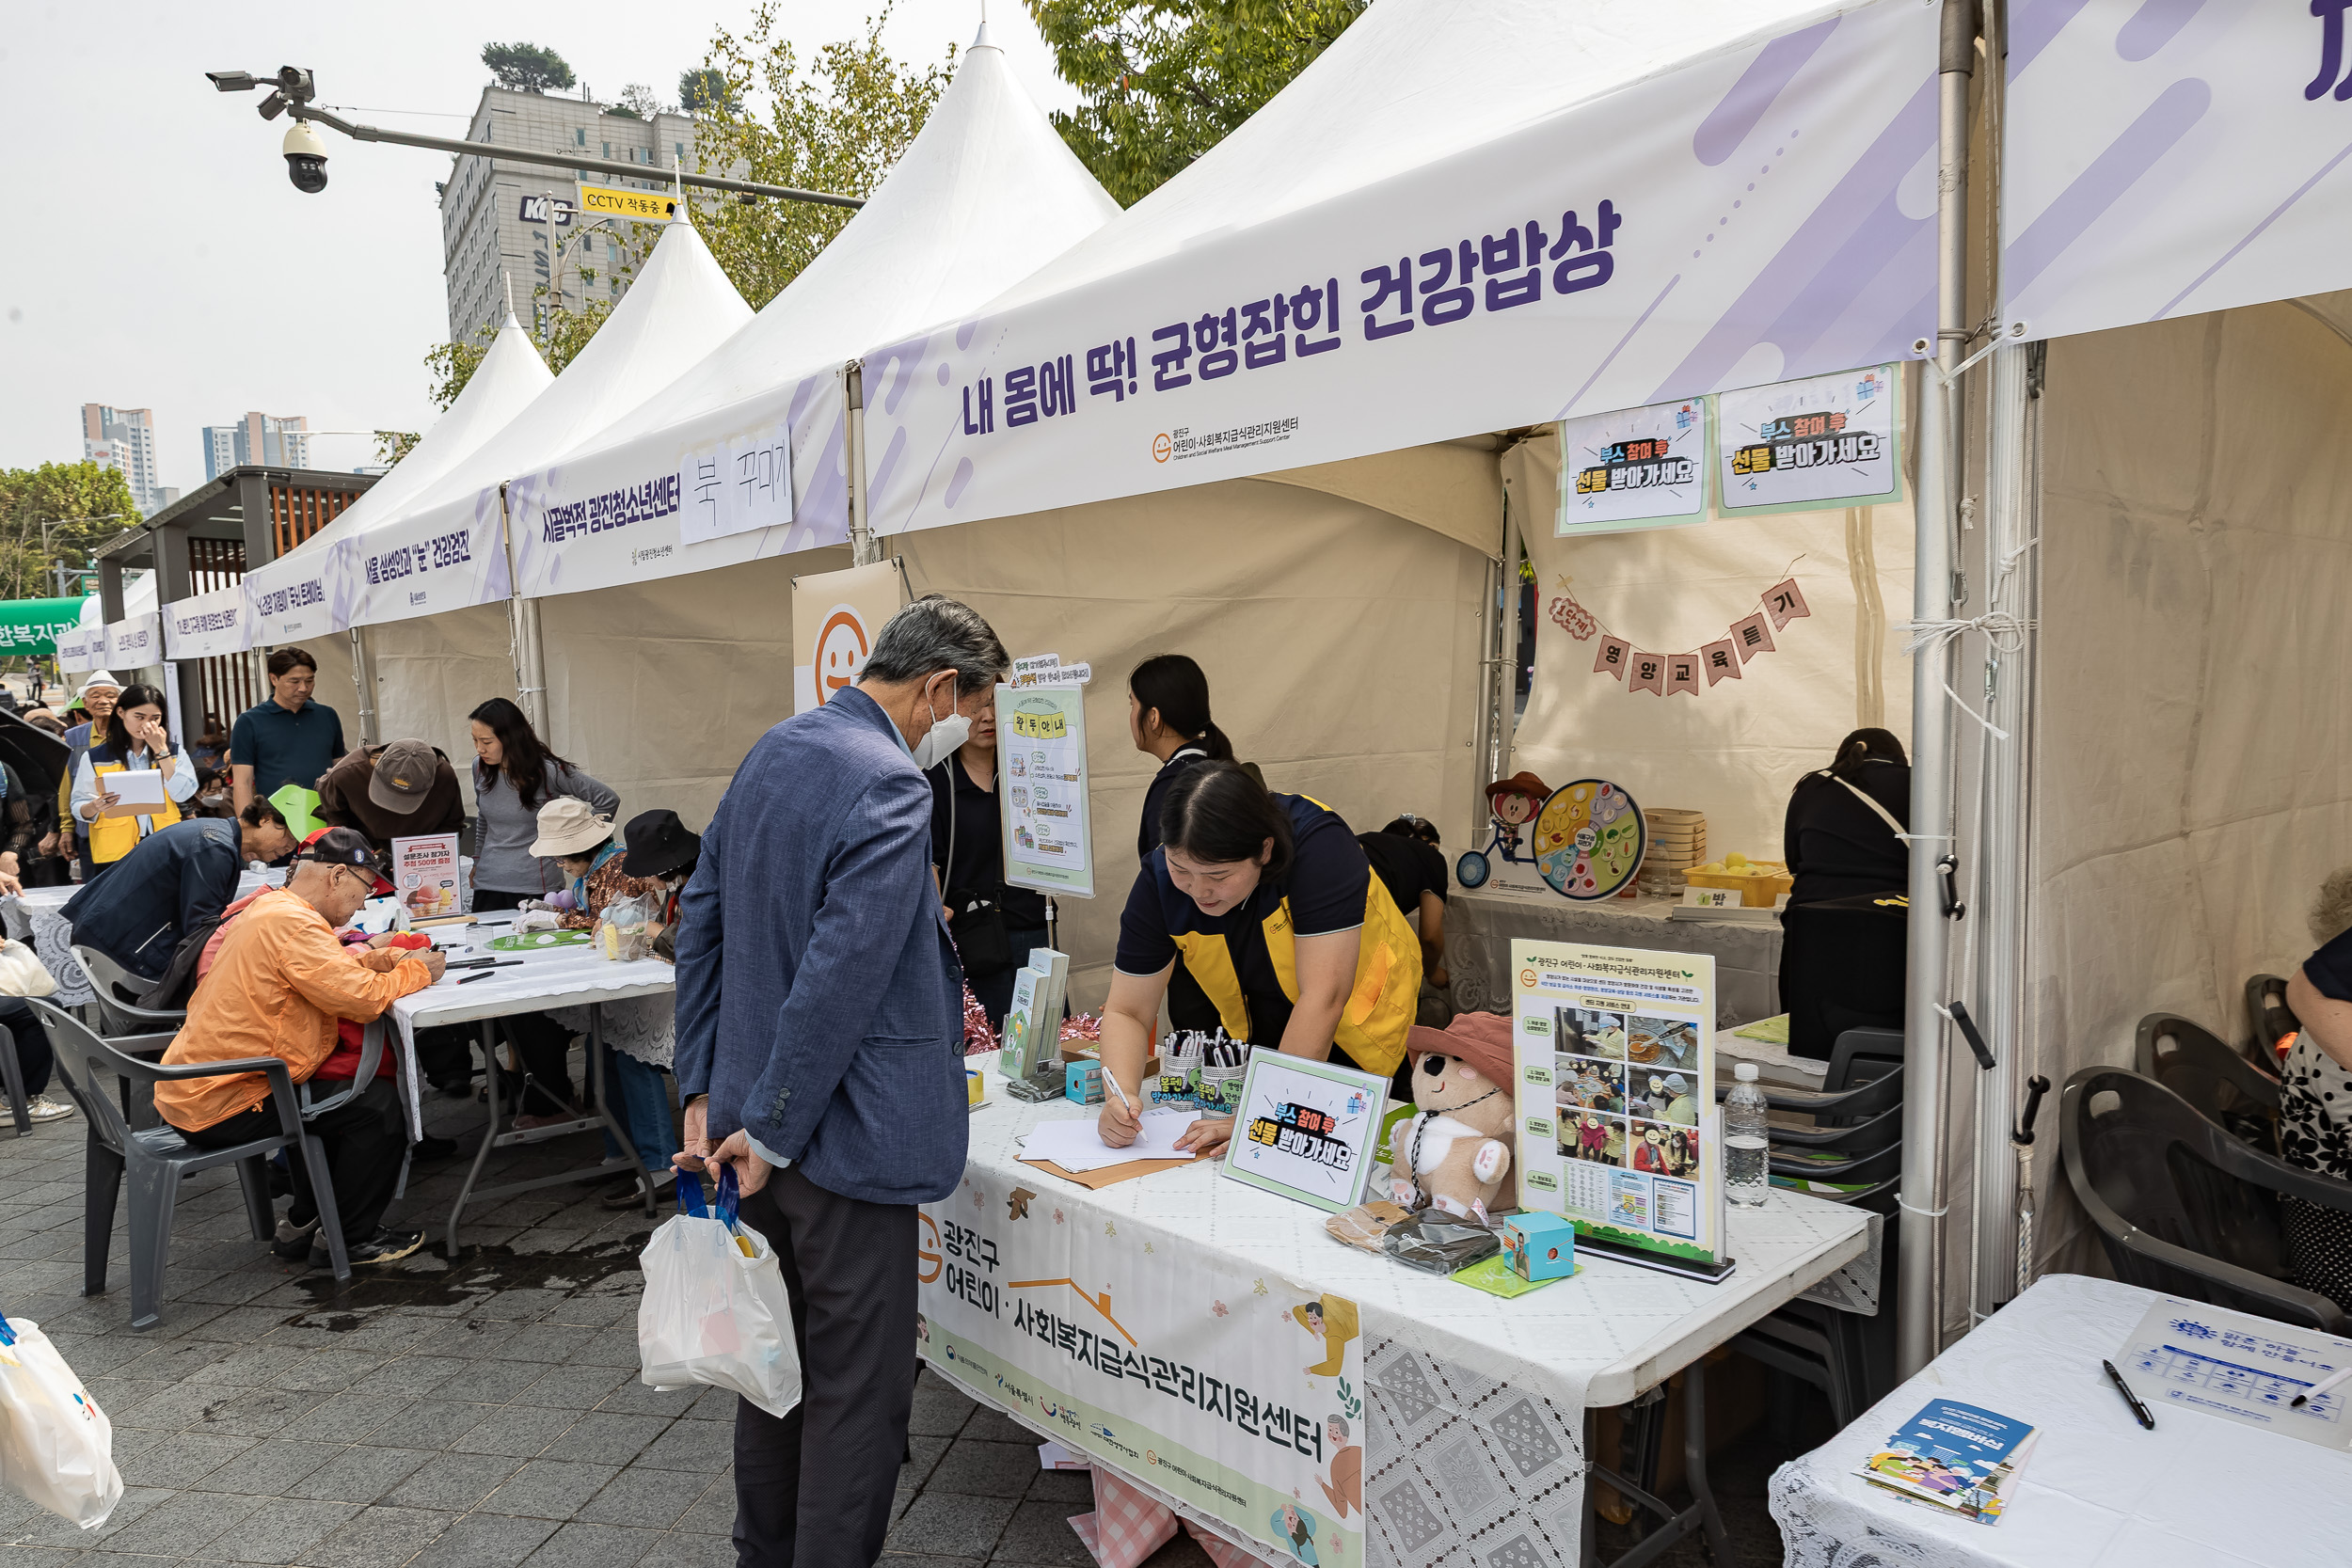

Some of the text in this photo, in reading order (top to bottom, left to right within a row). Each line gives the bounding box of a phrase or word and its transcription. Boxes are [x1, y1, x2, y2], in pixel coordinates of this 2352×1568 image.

[587, 193, 660, 214] CCTV 작동중
[962, 198, 1622, 436] 내 몸에 딱! 균형잡힌 건강밥상
[1172, 427, 1190, 439] 광진구
[1760, 411, 1848, 441] 부스 참여 후
[1599, 438, 1669, 465] 부스 참여 후
[1731, 435, 1882, 475] 선물 받아가세요
[693, 438, 787, 527] 북 꾸미기
[1576, 460, 1693, 495] 선물 받아가세요
[380, 546, 413, 582] 삼성안과
[432, 528, 471, 569] 건강검진
[1537, 957, 1559, 968] 광진구
[1160, 1075, 1183, 1093] 볼펜
[1199, 1082, 1216, 1101] 볼펜
[1193, 1096, 1232, 1115] 받아가세요
[1275, 1101, 1337, 1135] 부스 참여 후
[1248, 1117, 1279, 1148] 선물
[1278, 1128, 1353, 1172] 받아가세요
[943, 1219, 1000, 1273] 광진구
[1157, 1456, 1171, 1470] 광진구
